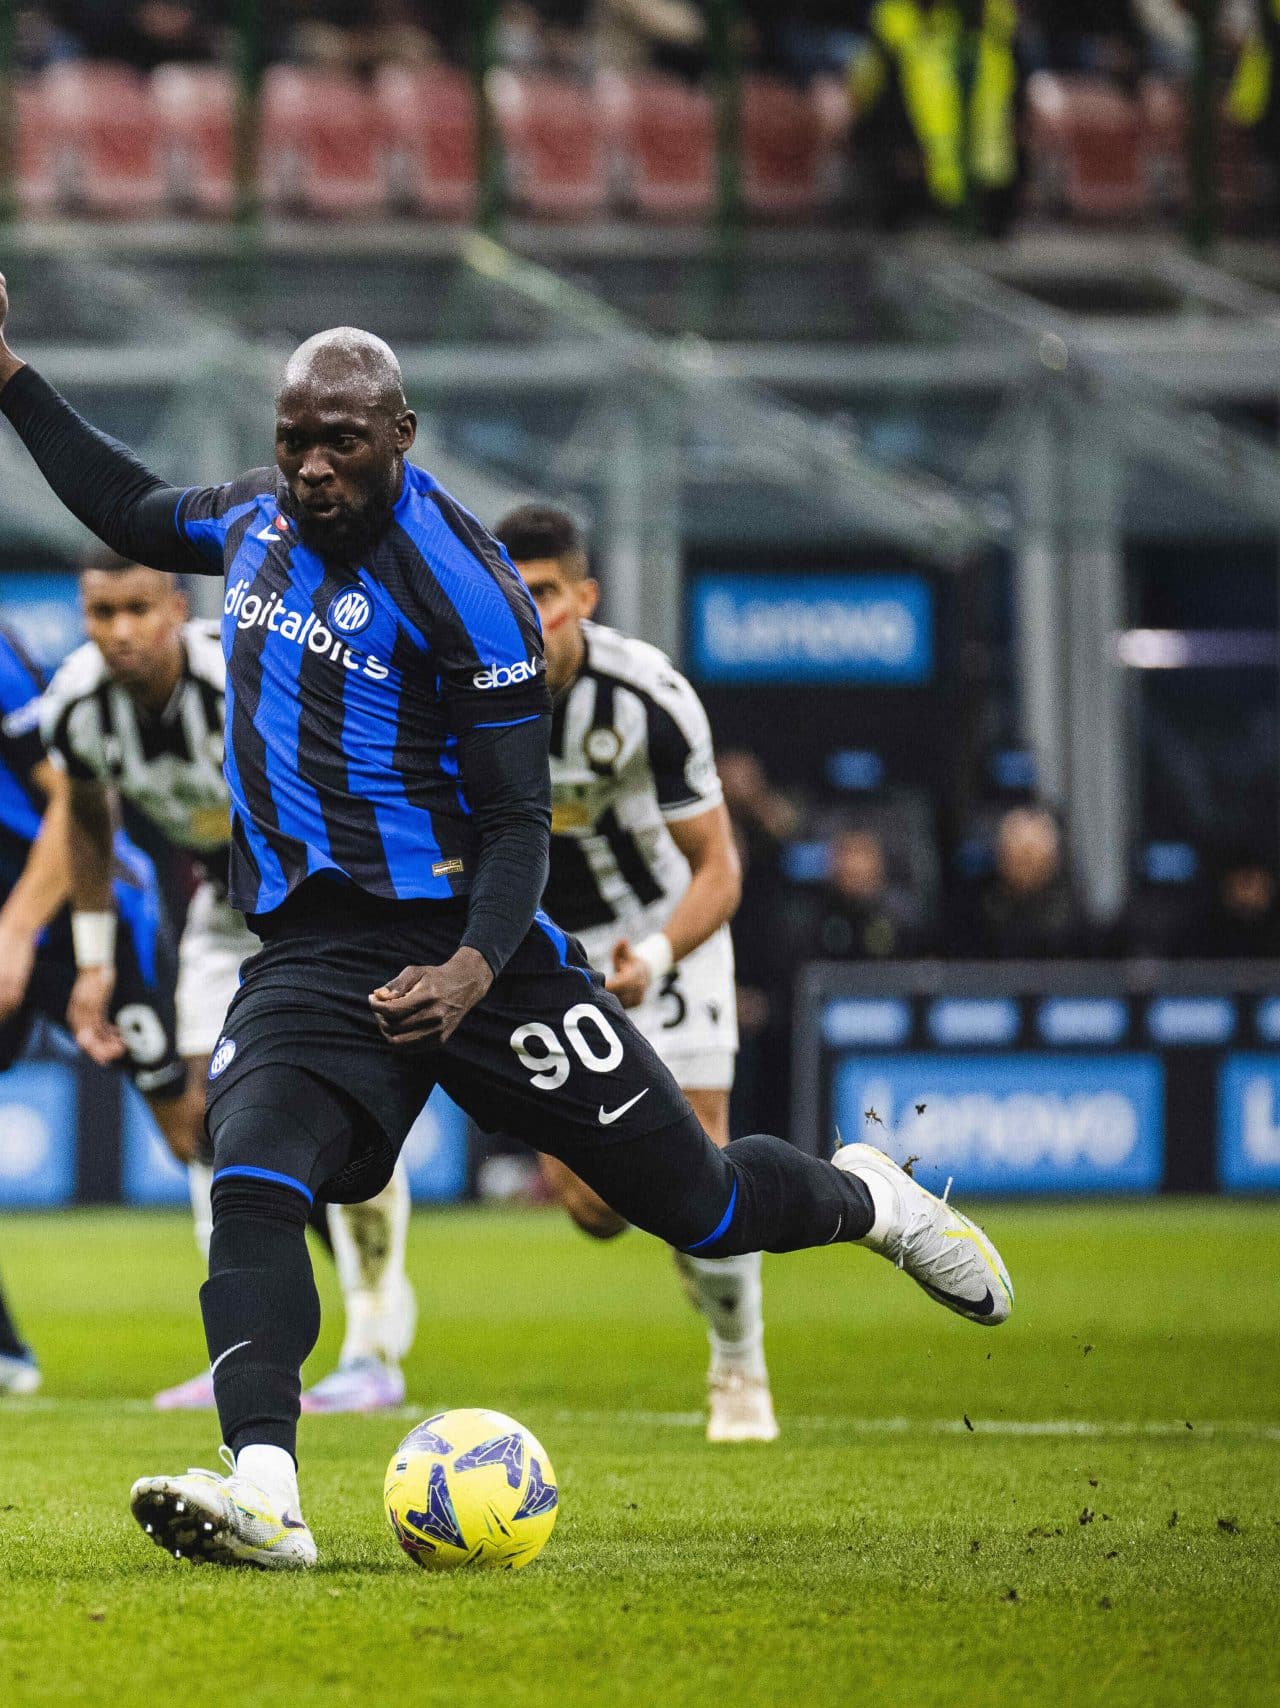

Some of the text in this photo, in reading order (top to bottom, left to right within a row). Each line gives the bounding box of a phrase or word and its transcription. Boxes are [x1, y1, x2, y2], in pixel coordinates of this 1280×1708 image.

[224, 578, 389, 680] digitalbits
[115, 1003, 167, 1064] 9
[510, 1003, 624, 1090] 90
[858, 1077, 1136, 1166] Lenovo
